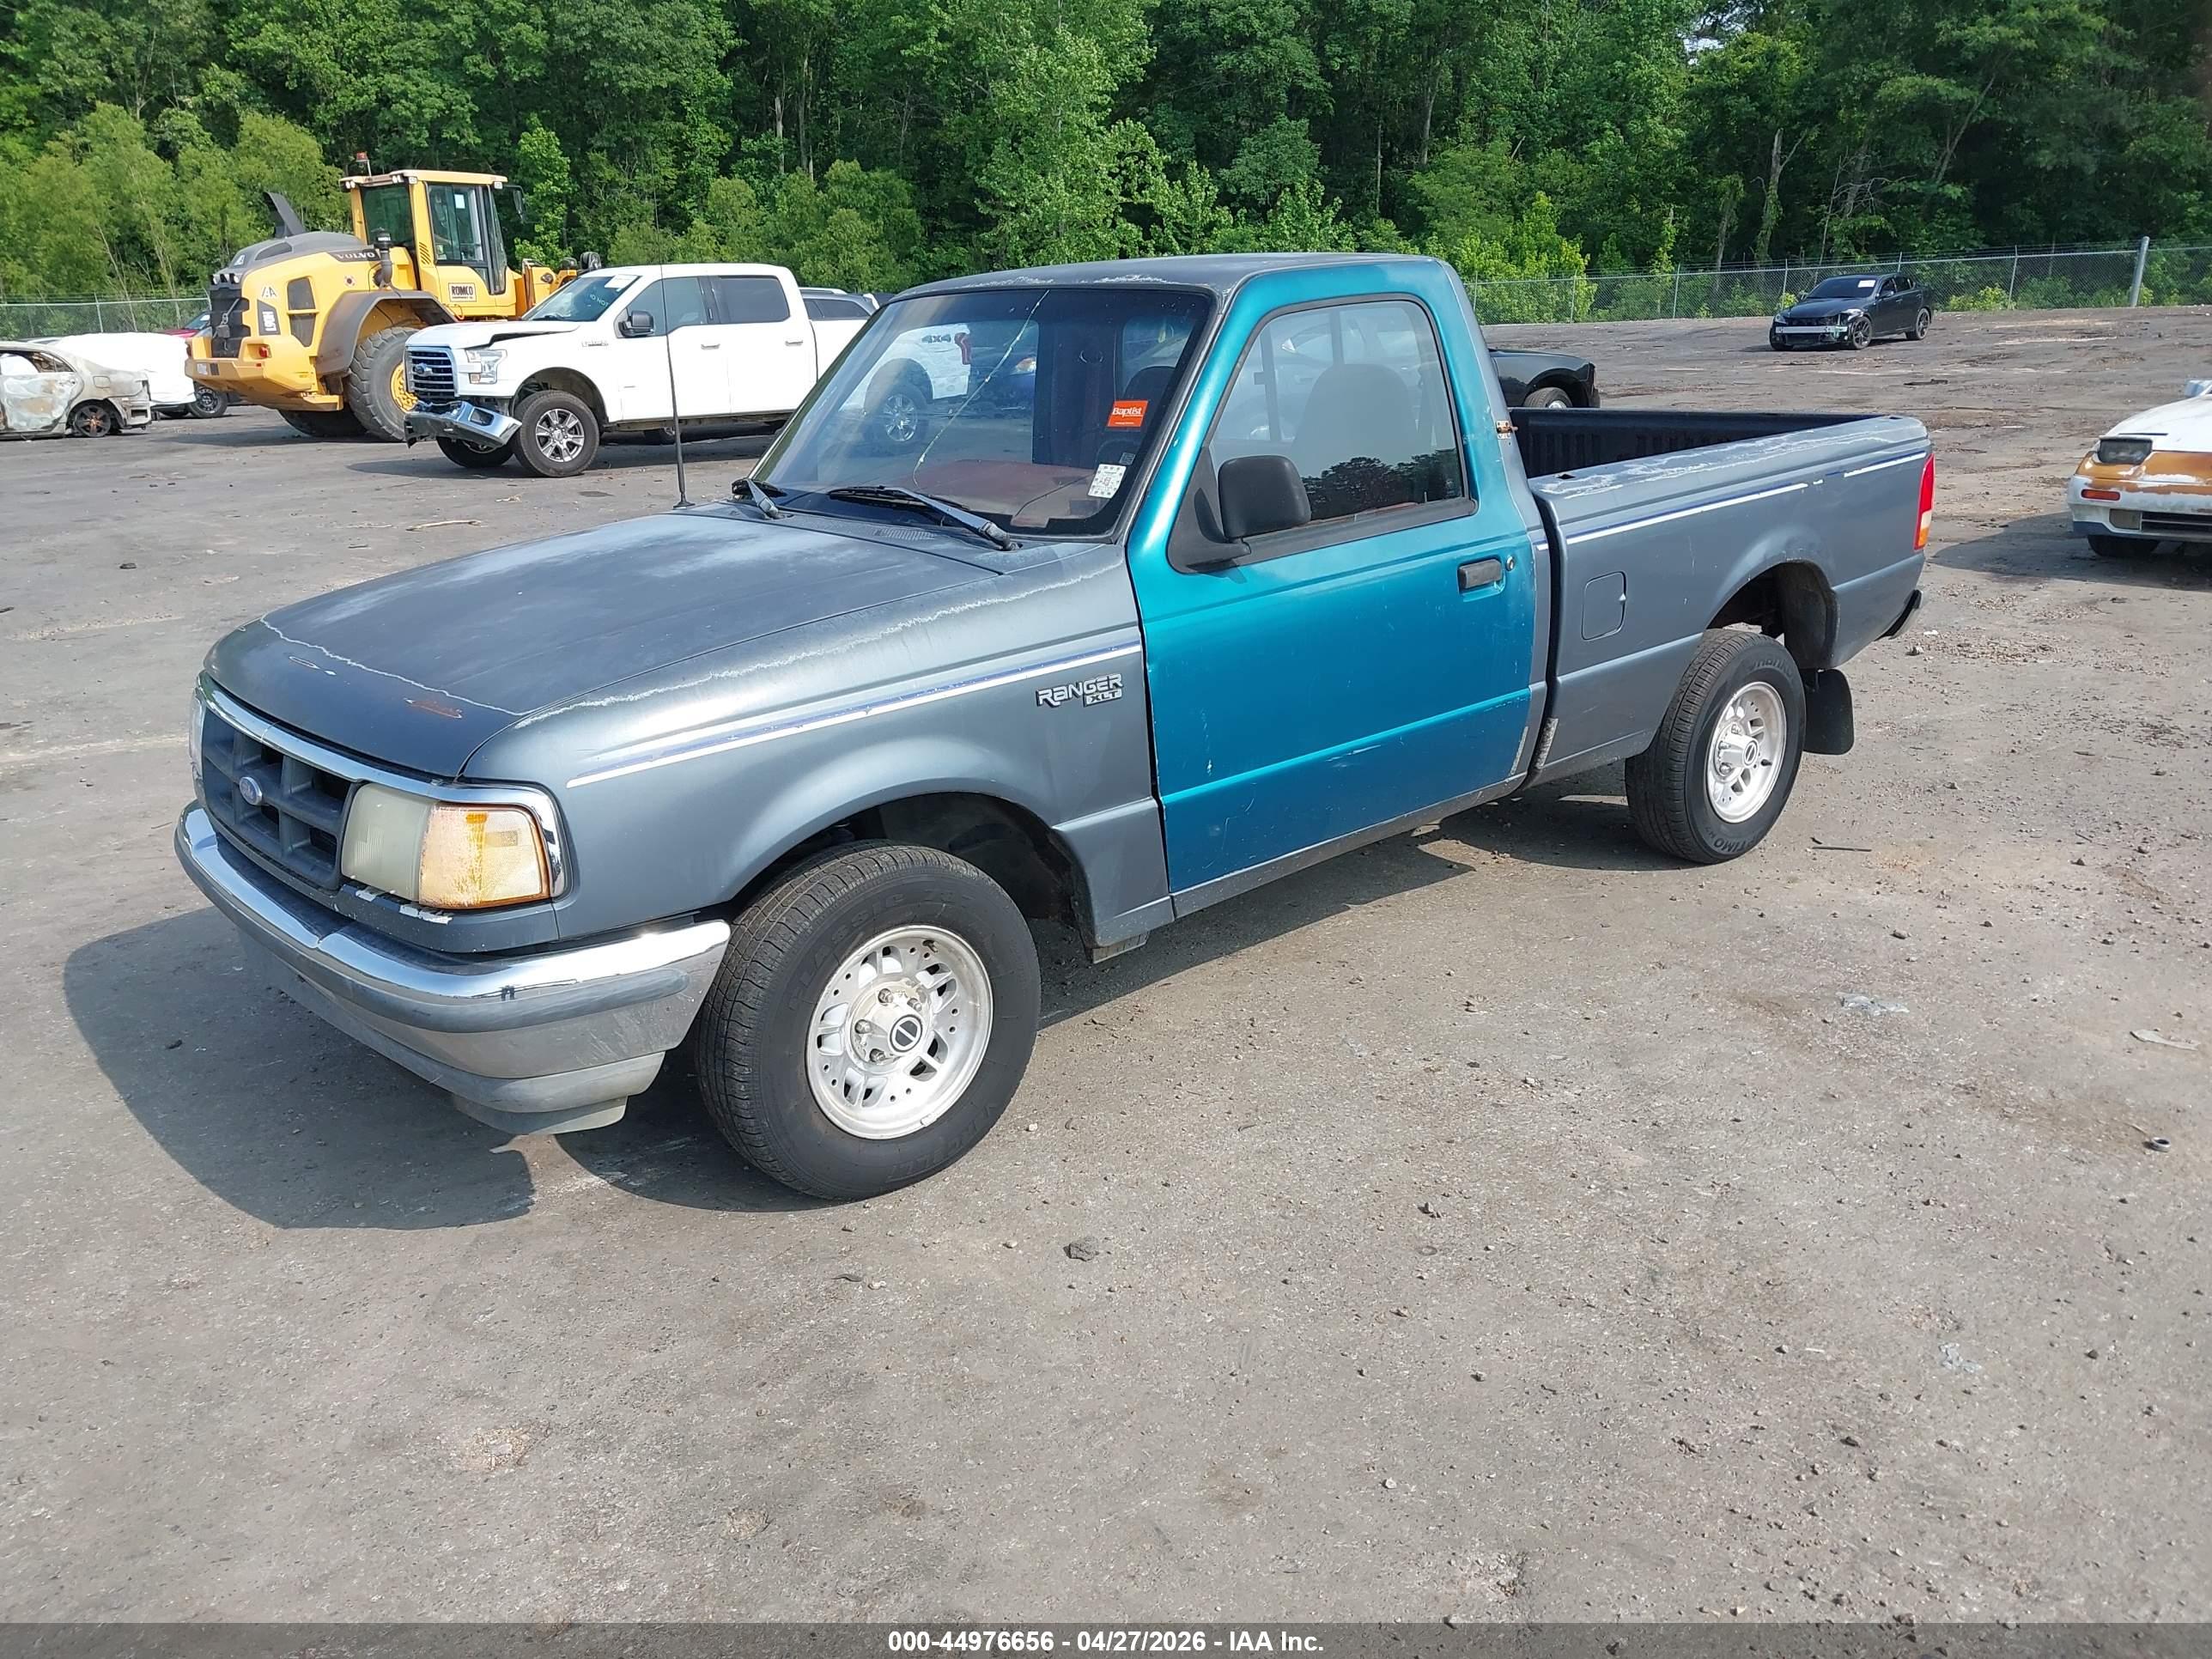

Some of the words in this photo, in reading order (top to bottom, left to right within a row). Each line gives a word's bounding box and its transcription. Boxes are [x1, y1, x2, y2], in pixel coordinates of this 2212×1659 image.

[451, 285, 474, 296] ROMCO
[1112, 407, 1143, 417] Baptist
[1086, 690, 1121, 703] XLT
